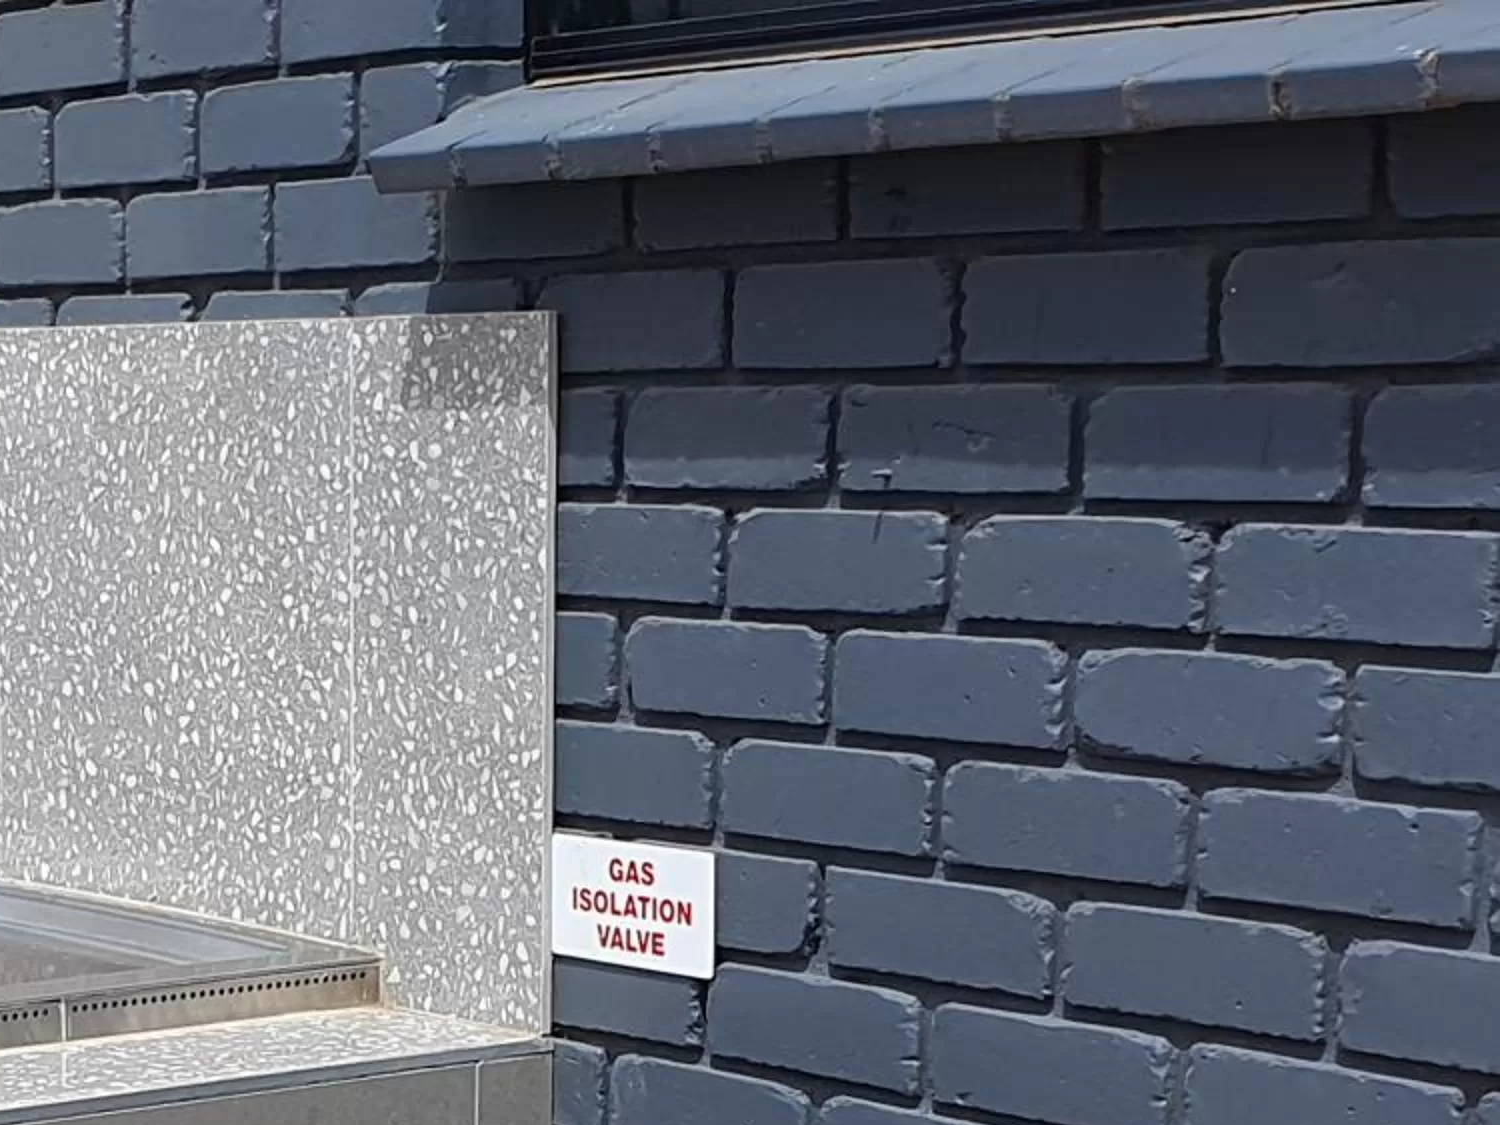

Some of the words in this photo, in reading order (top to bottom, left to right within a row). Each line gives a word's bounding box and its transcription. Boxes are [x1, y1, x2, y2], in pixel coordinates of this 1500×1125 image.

[609, 857, 655, 886] GAS
[572, 886, 693, 926] ISOLATION
[596, 923, 666, 957] VALVE
